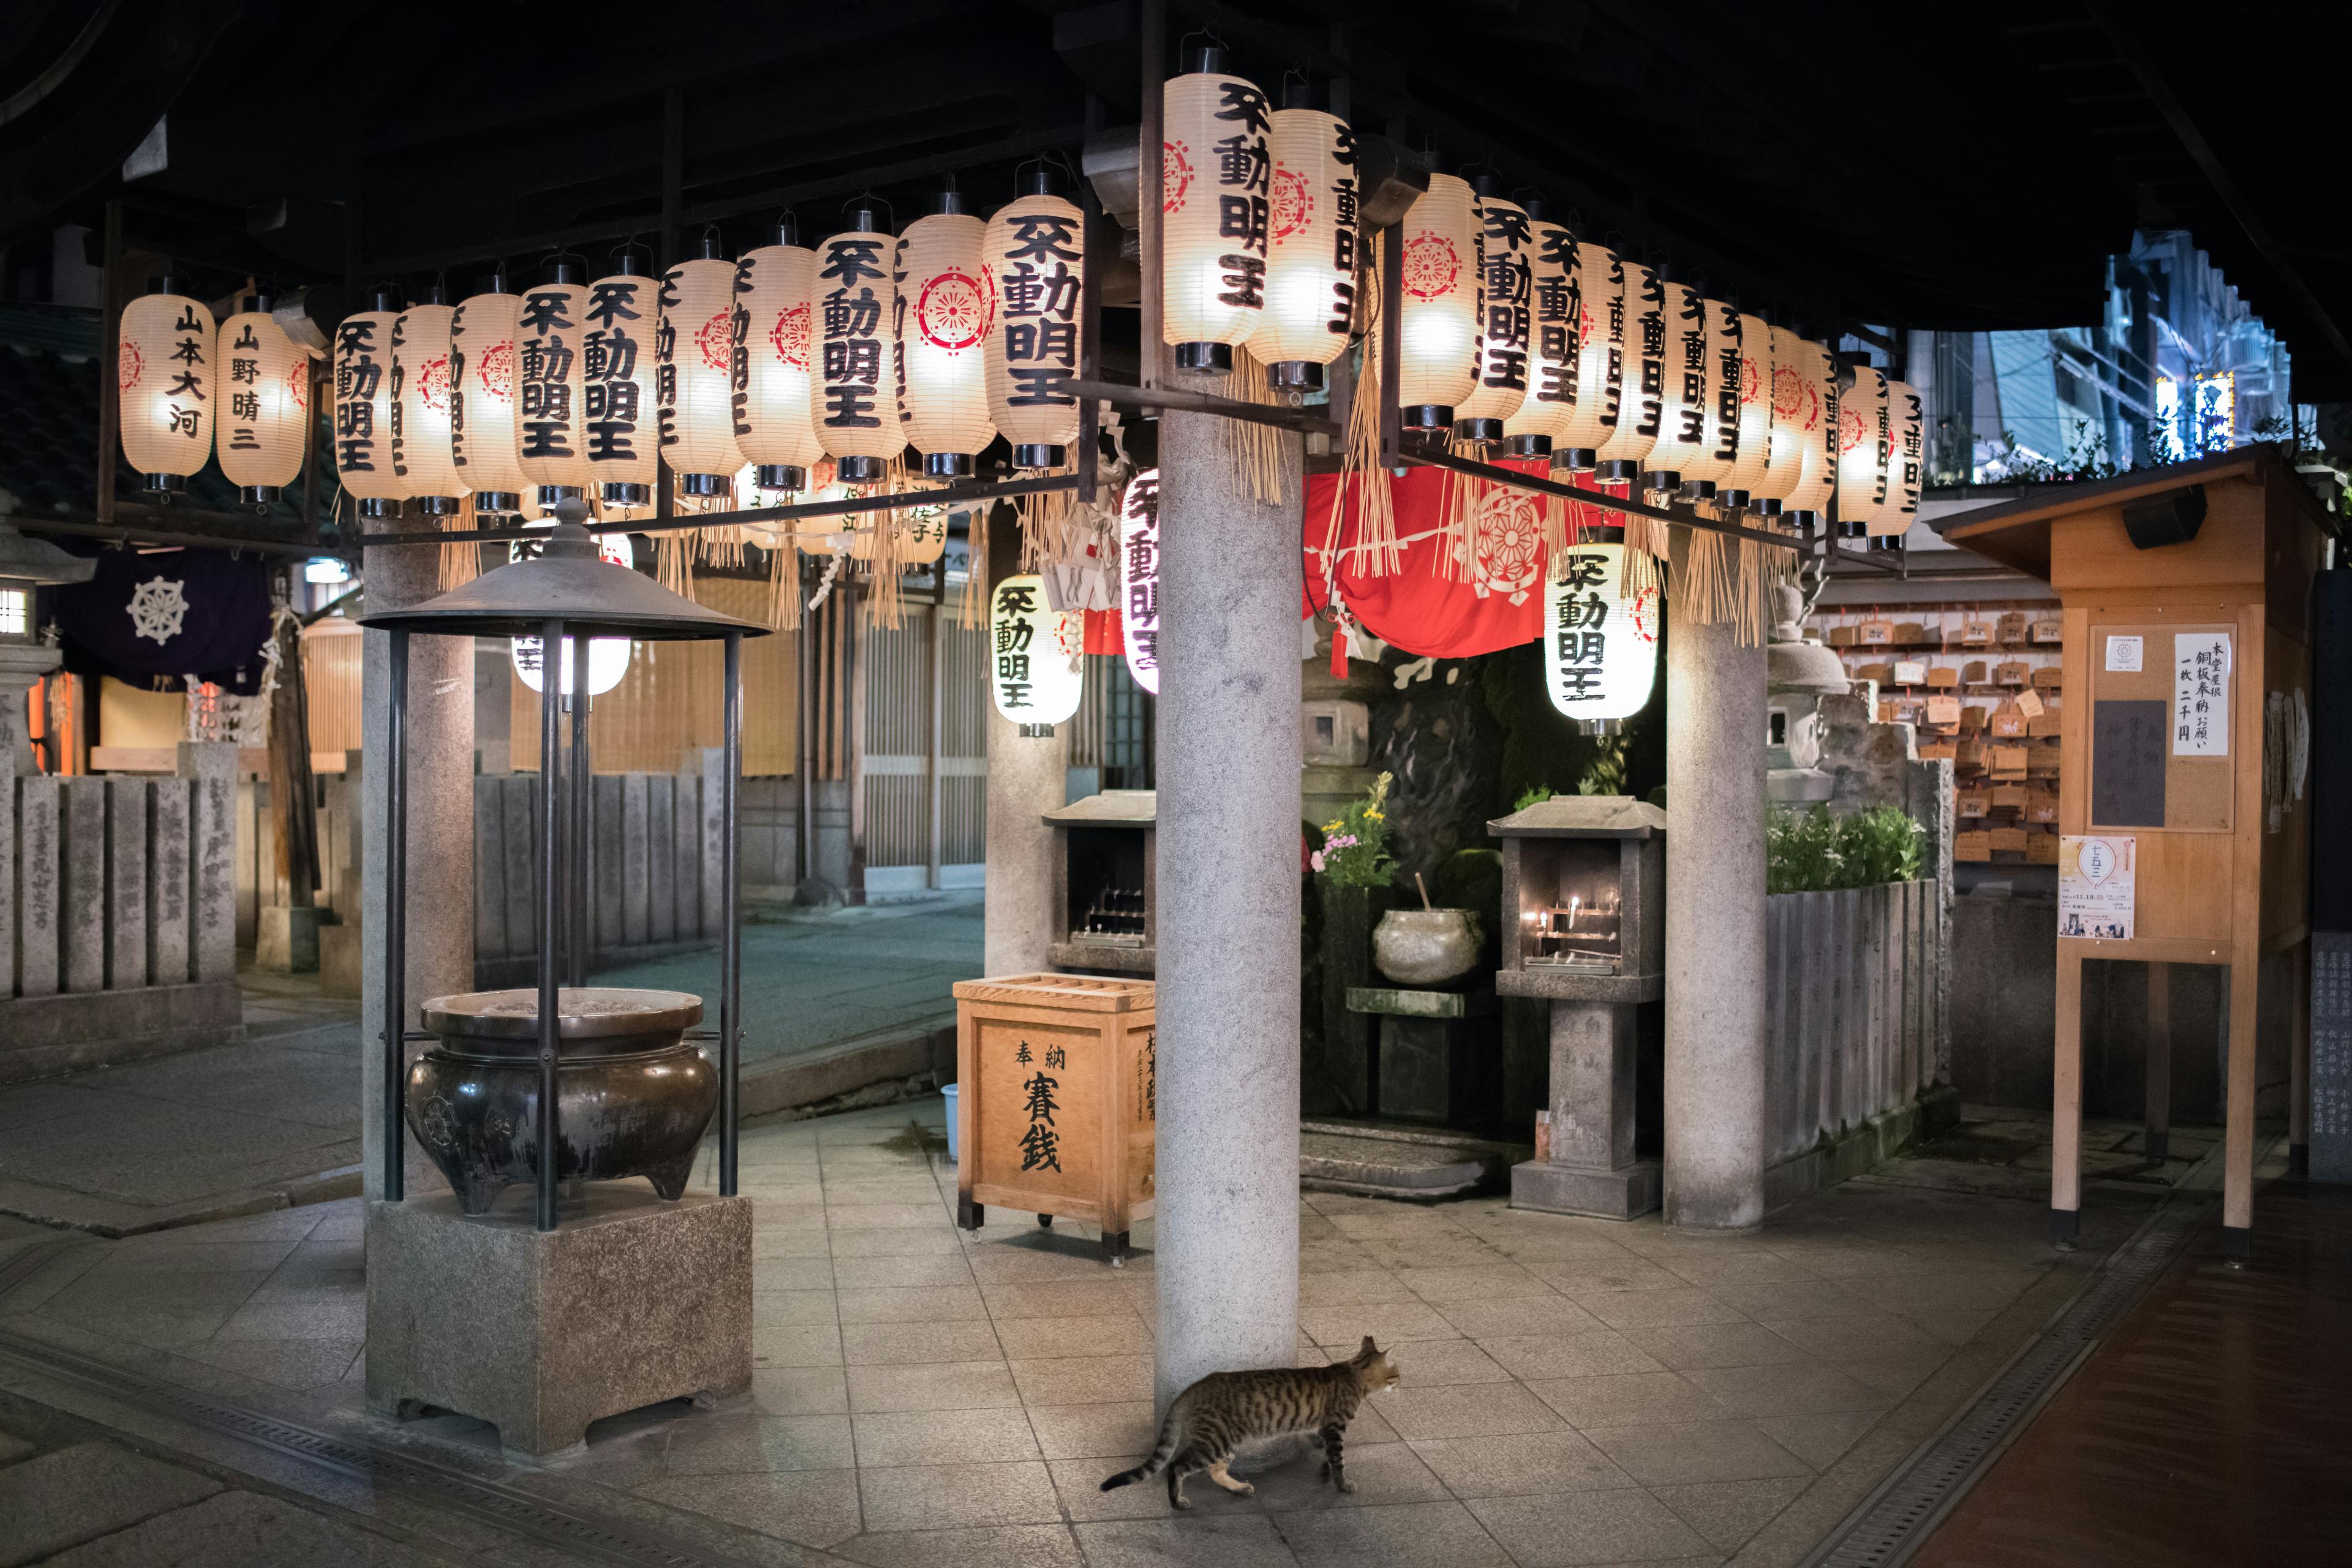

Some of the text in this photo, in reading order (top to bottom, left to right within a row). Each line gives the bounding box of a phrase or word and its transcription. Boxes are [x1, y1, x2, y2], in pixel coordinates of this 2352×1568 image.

[1212, 82, 1272, 309] 不動明王
[164, 304, 207, 439] 山本大河
[583, 283, 642, 462] 不動明王
[820, 240, 886, 428] 不動明王
[1003, 215, 1083, 407] 不動明王
[1483, 207, 1533, 392] 不動明王
[1534, 230, 1582, 407] 不動明王
[229, 324, 261, 450] 山野晴三
[337, 321, 382, 472] 不動明王
[519, 292, 575, 459] 不動明王
[995, 586, 1038, 708] 不動明王
[1556, 554, 1610, 701] 不動明王
[2194, 651, 2212, 749] 銅板奉納お願い
[2209, 642, 2224, 698] 本堂屋根
[2091, 845, 2102, 878] 七五三
[1015, 1040, 1066, 1071] 奉納
[1018, 1071, 1062, 1174] 賽銭
